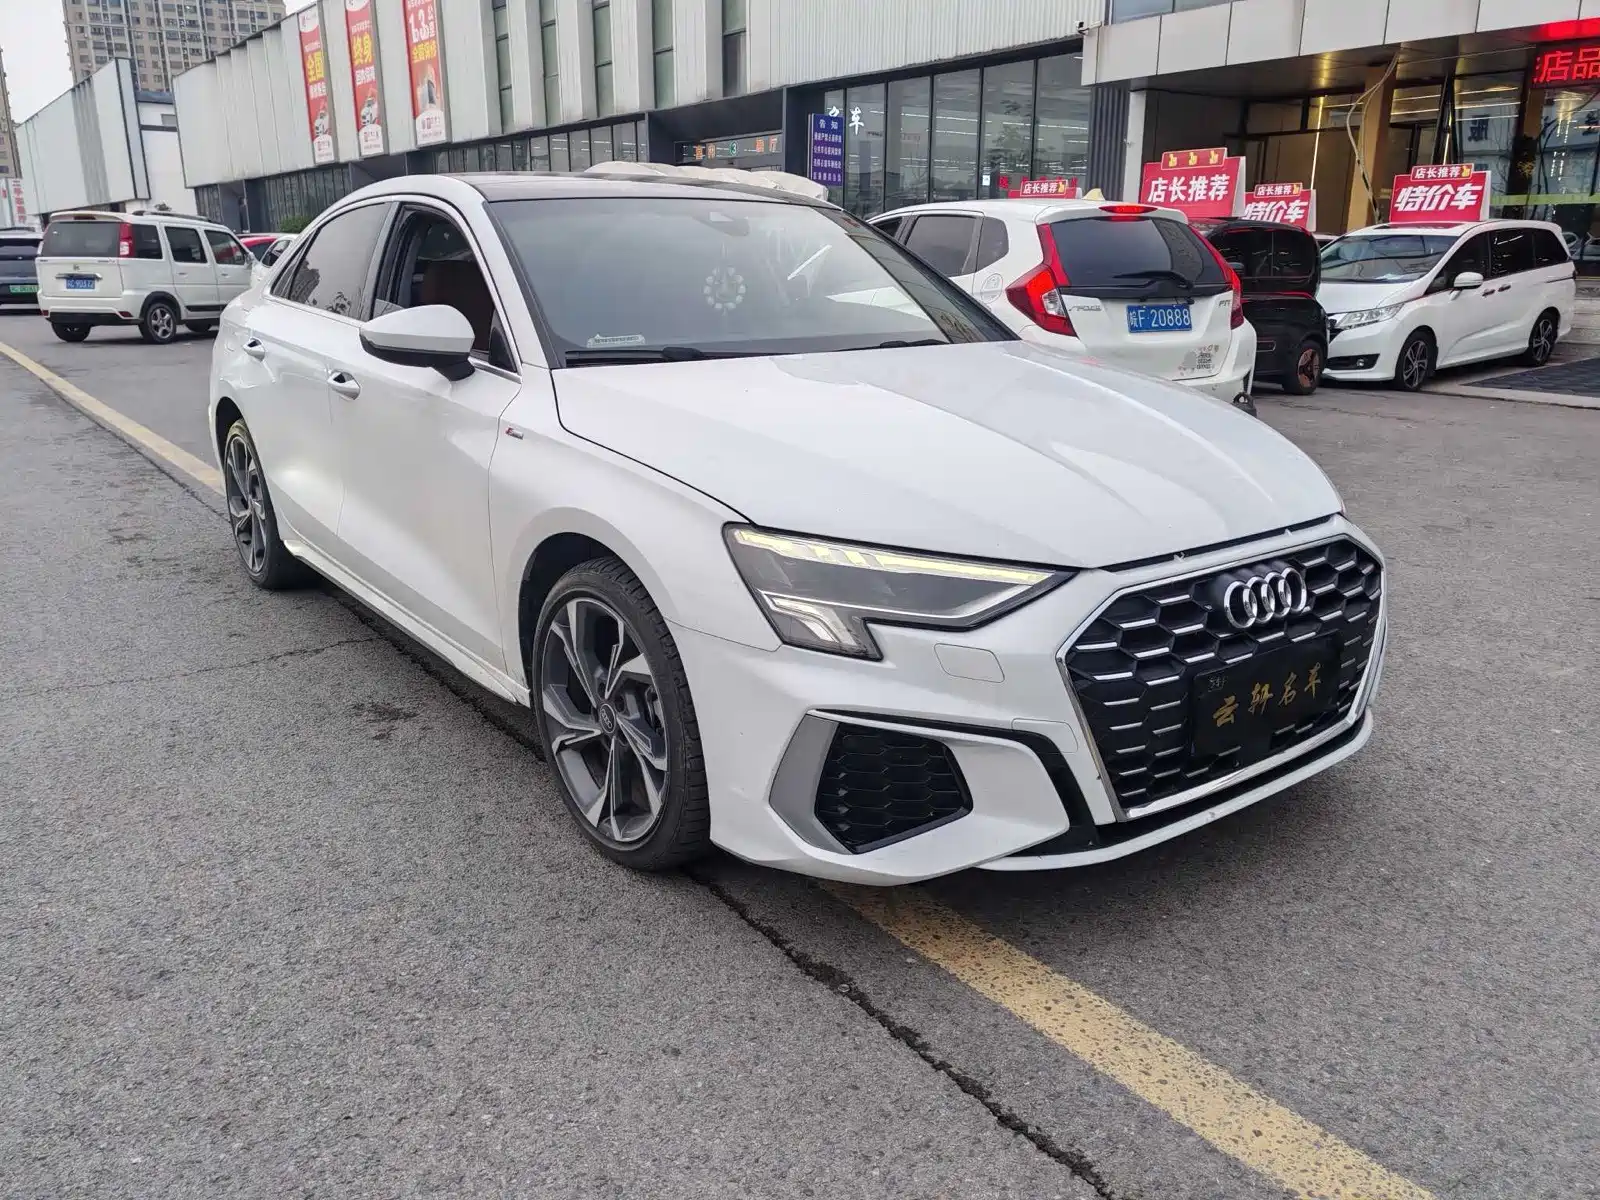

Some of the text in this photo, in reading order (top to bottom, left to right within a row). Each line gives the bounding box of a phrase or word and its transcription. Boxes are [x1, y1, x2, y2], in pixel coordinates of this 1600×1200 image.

[819, 119, 839, 130] 告知
[1415, 166, 1461, 179] 店长推荐
[1023, 182, 1058, 194] 店长推荐
[1147, 174, 1230, 203] 店长推荐
[1256, 185, 1292, 196] 店长推荐
[1394, 183, 1483, 212] 特价车
[1242, 199, 1309, 223] 特价车
